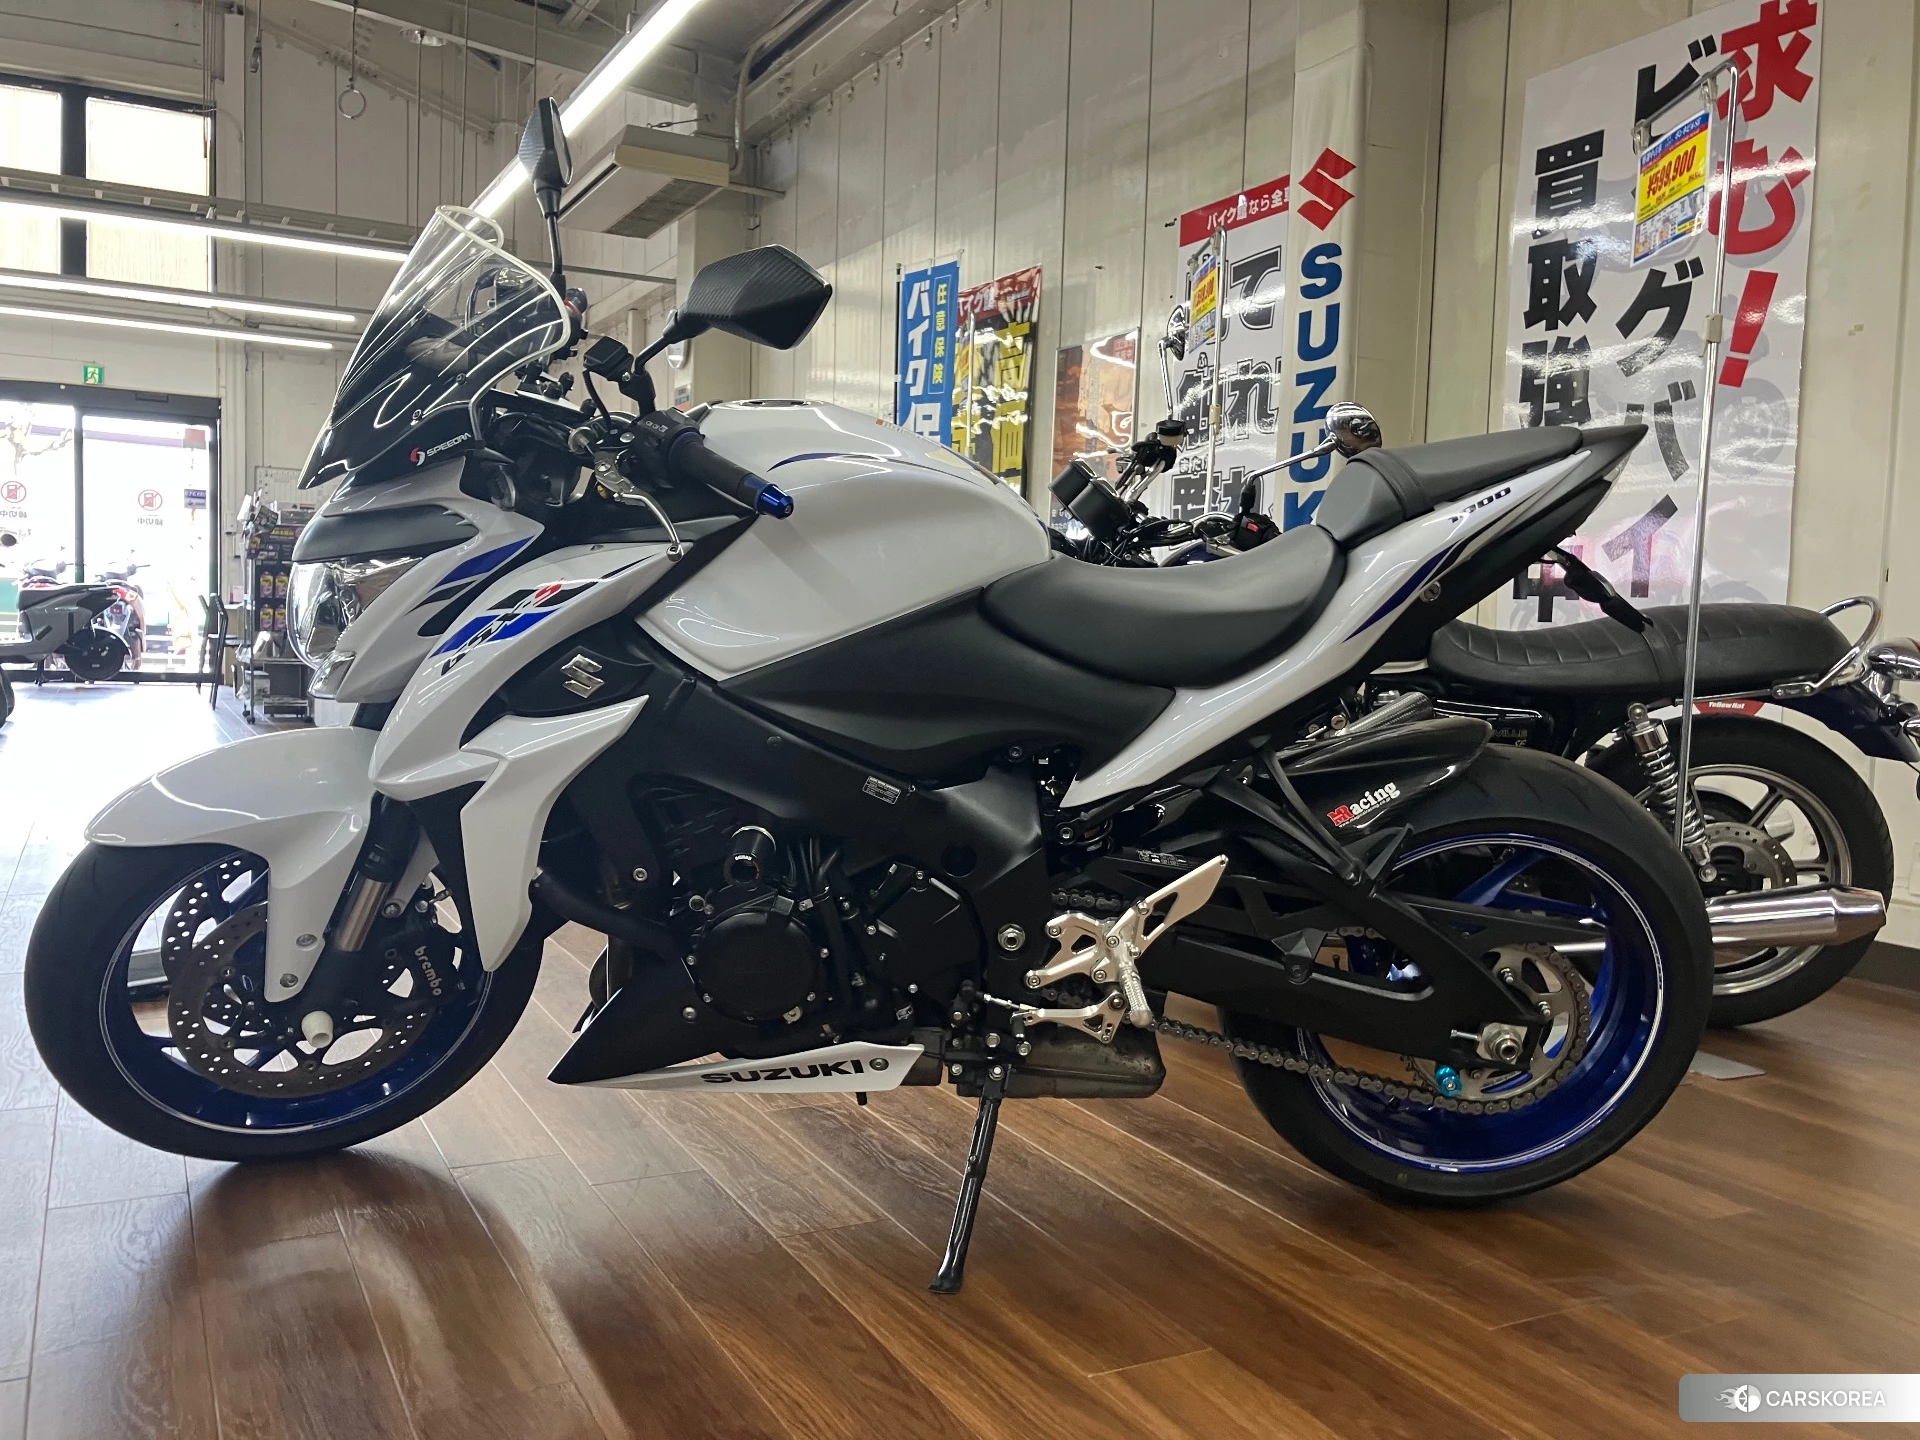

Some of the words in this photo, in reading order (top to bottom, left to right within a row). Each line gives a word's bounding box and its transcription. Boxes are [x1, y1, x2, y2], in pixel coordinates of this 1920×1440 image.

[932, 283, 948, 384] 任意保険
[414, 945, 442, 996] brembo
[701, 1059, 865, 1083] SUZUKI
